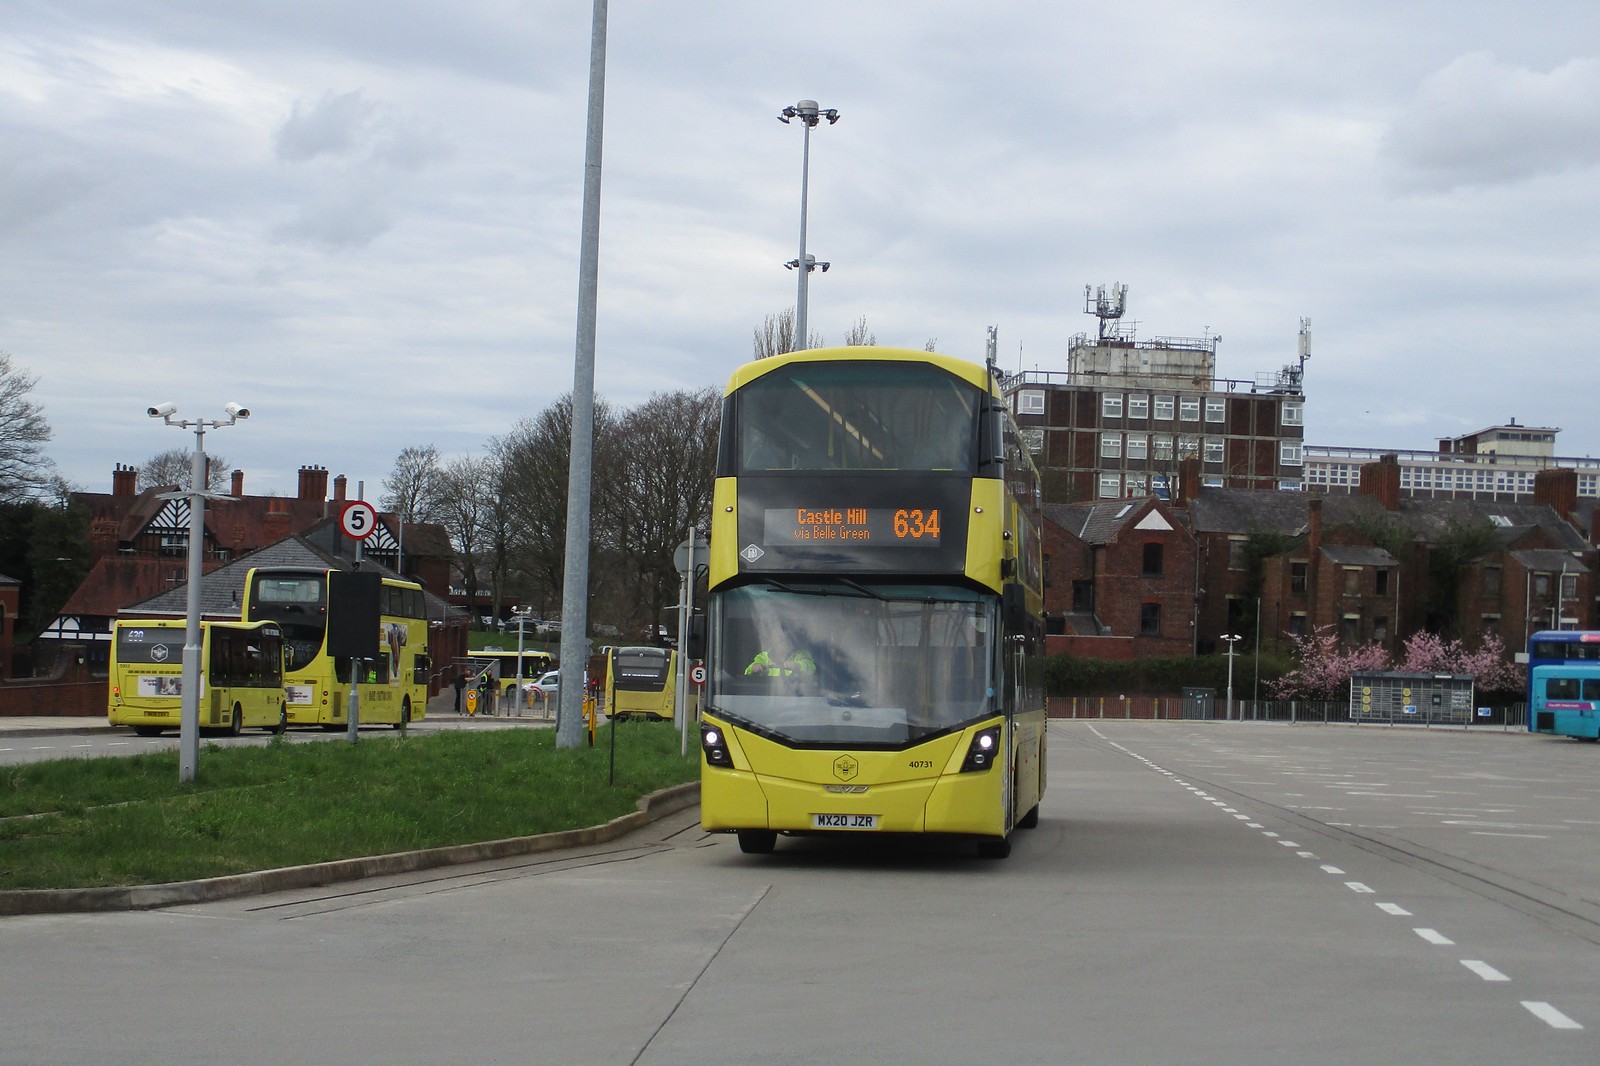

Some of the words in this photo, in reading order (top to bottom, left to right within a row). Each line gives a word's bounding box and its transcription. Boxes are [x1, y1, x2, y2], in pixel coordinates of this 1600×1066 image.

[351, 510, 365, 530] 5
[797, 508, 842, 525] Castle
[847, 508, 867, 525] Hill
[893, 509, 941, 538] 634
[794, 528, 810, 539] via
[813, 526, 835, 539] Belle
[839, 526, 870, 539] Green
[696, 670, 702, 680] 5
[909, 760, 933, 768] 40731
[818, 815, 848, 827] MX20
[850, 816, 873, 827] JZR
